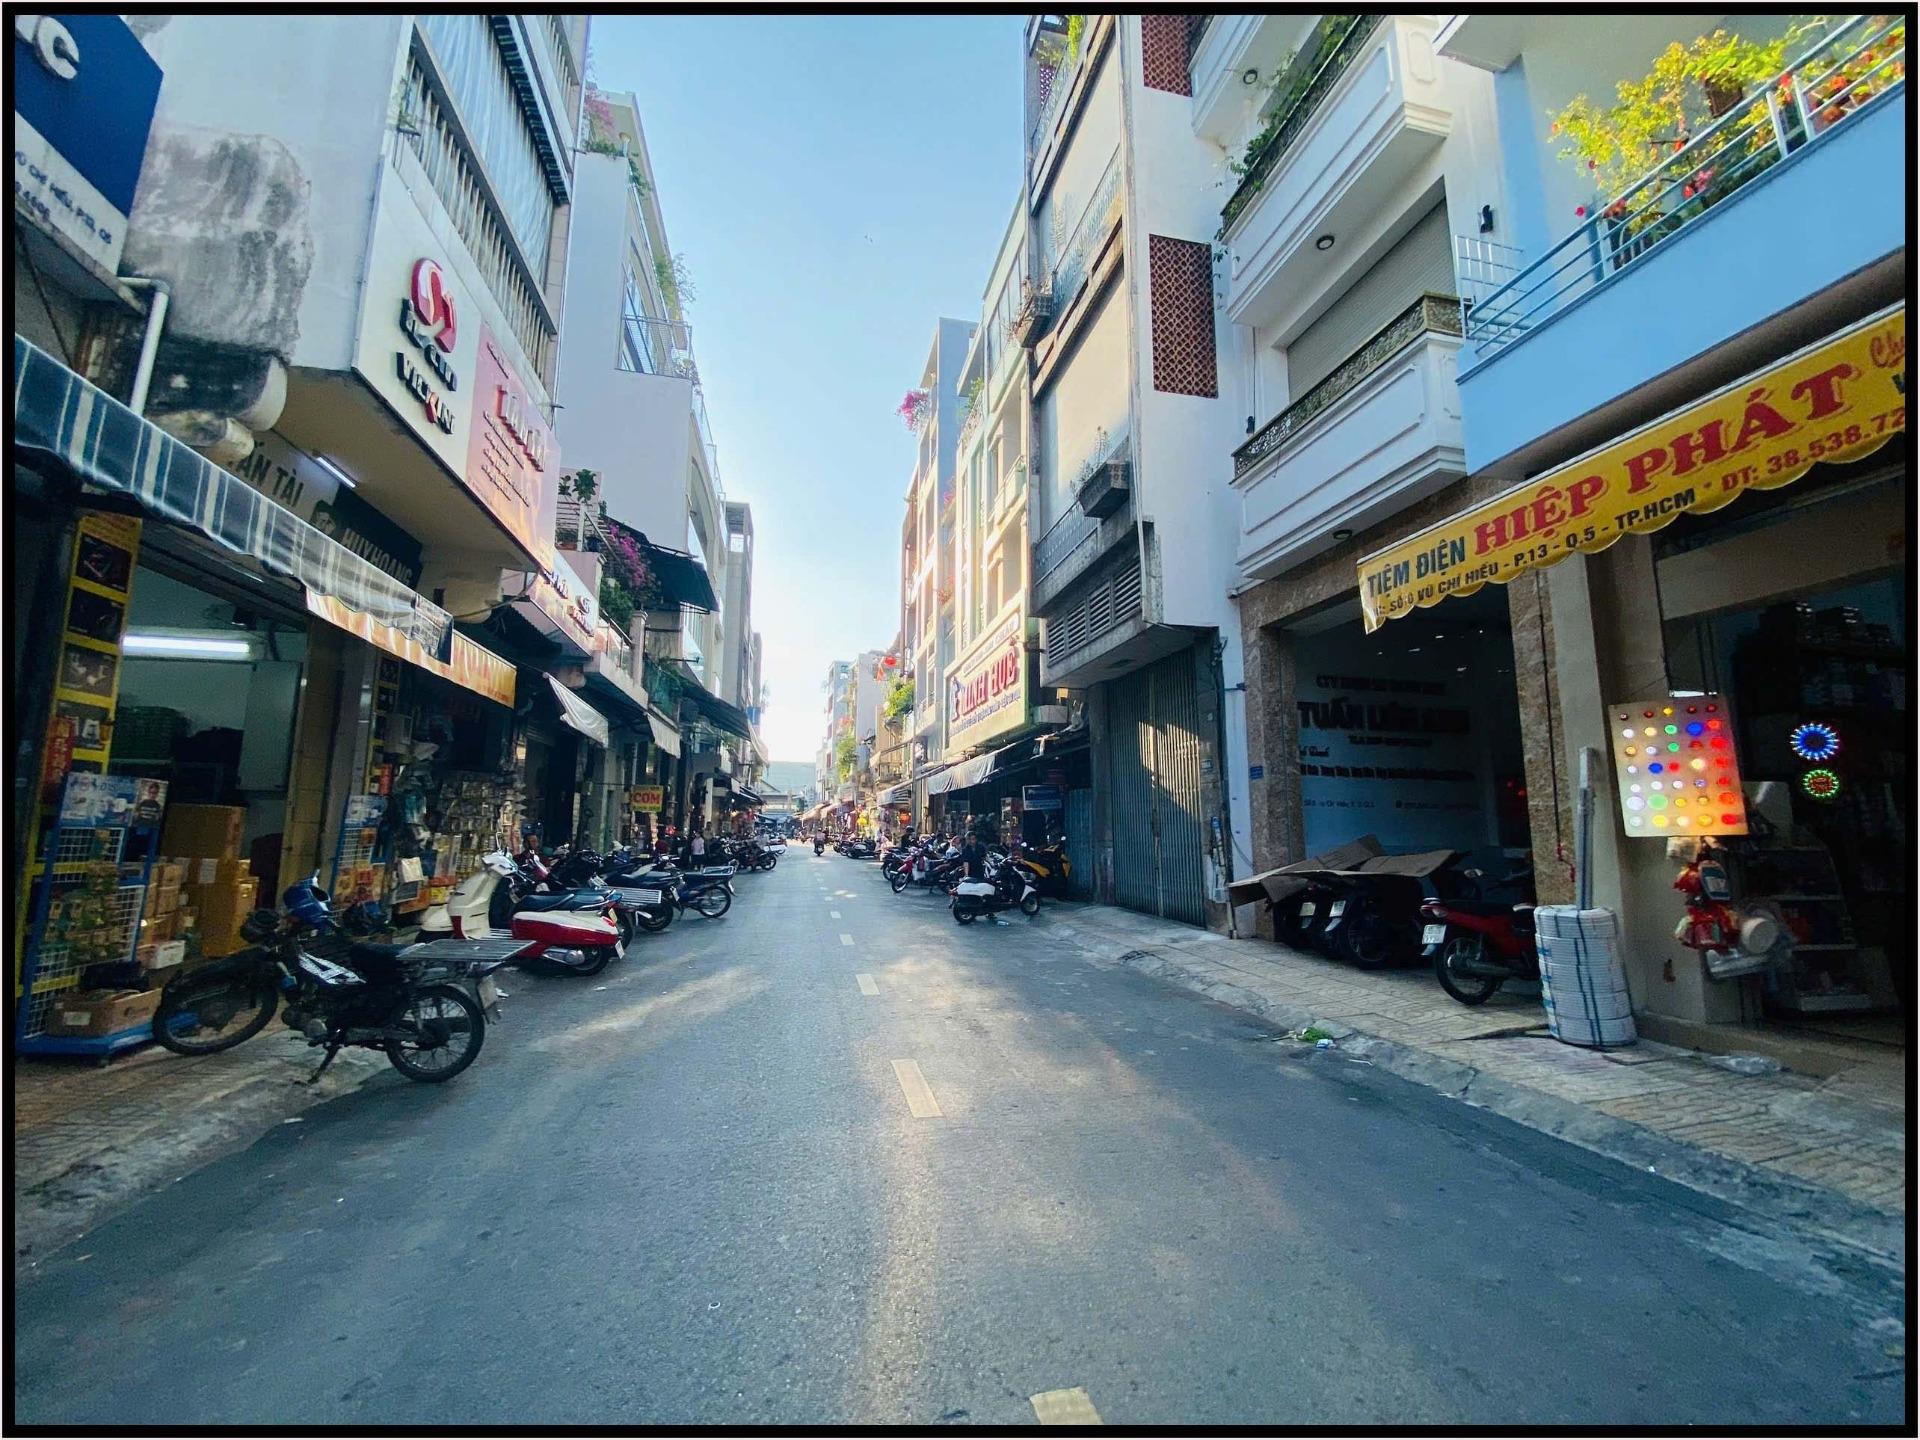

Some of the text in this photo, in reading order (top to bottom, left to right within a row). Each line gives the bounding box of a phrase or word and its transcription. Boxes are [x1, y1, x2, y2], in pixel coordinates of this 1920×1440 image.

[1367, 363, 1860, 598] TIỆM ĐIỆN HIỆP PHÁT
[1514, 544, 1548, 567] P.13
[1615, 488, 1696, 531] TP.HCM
